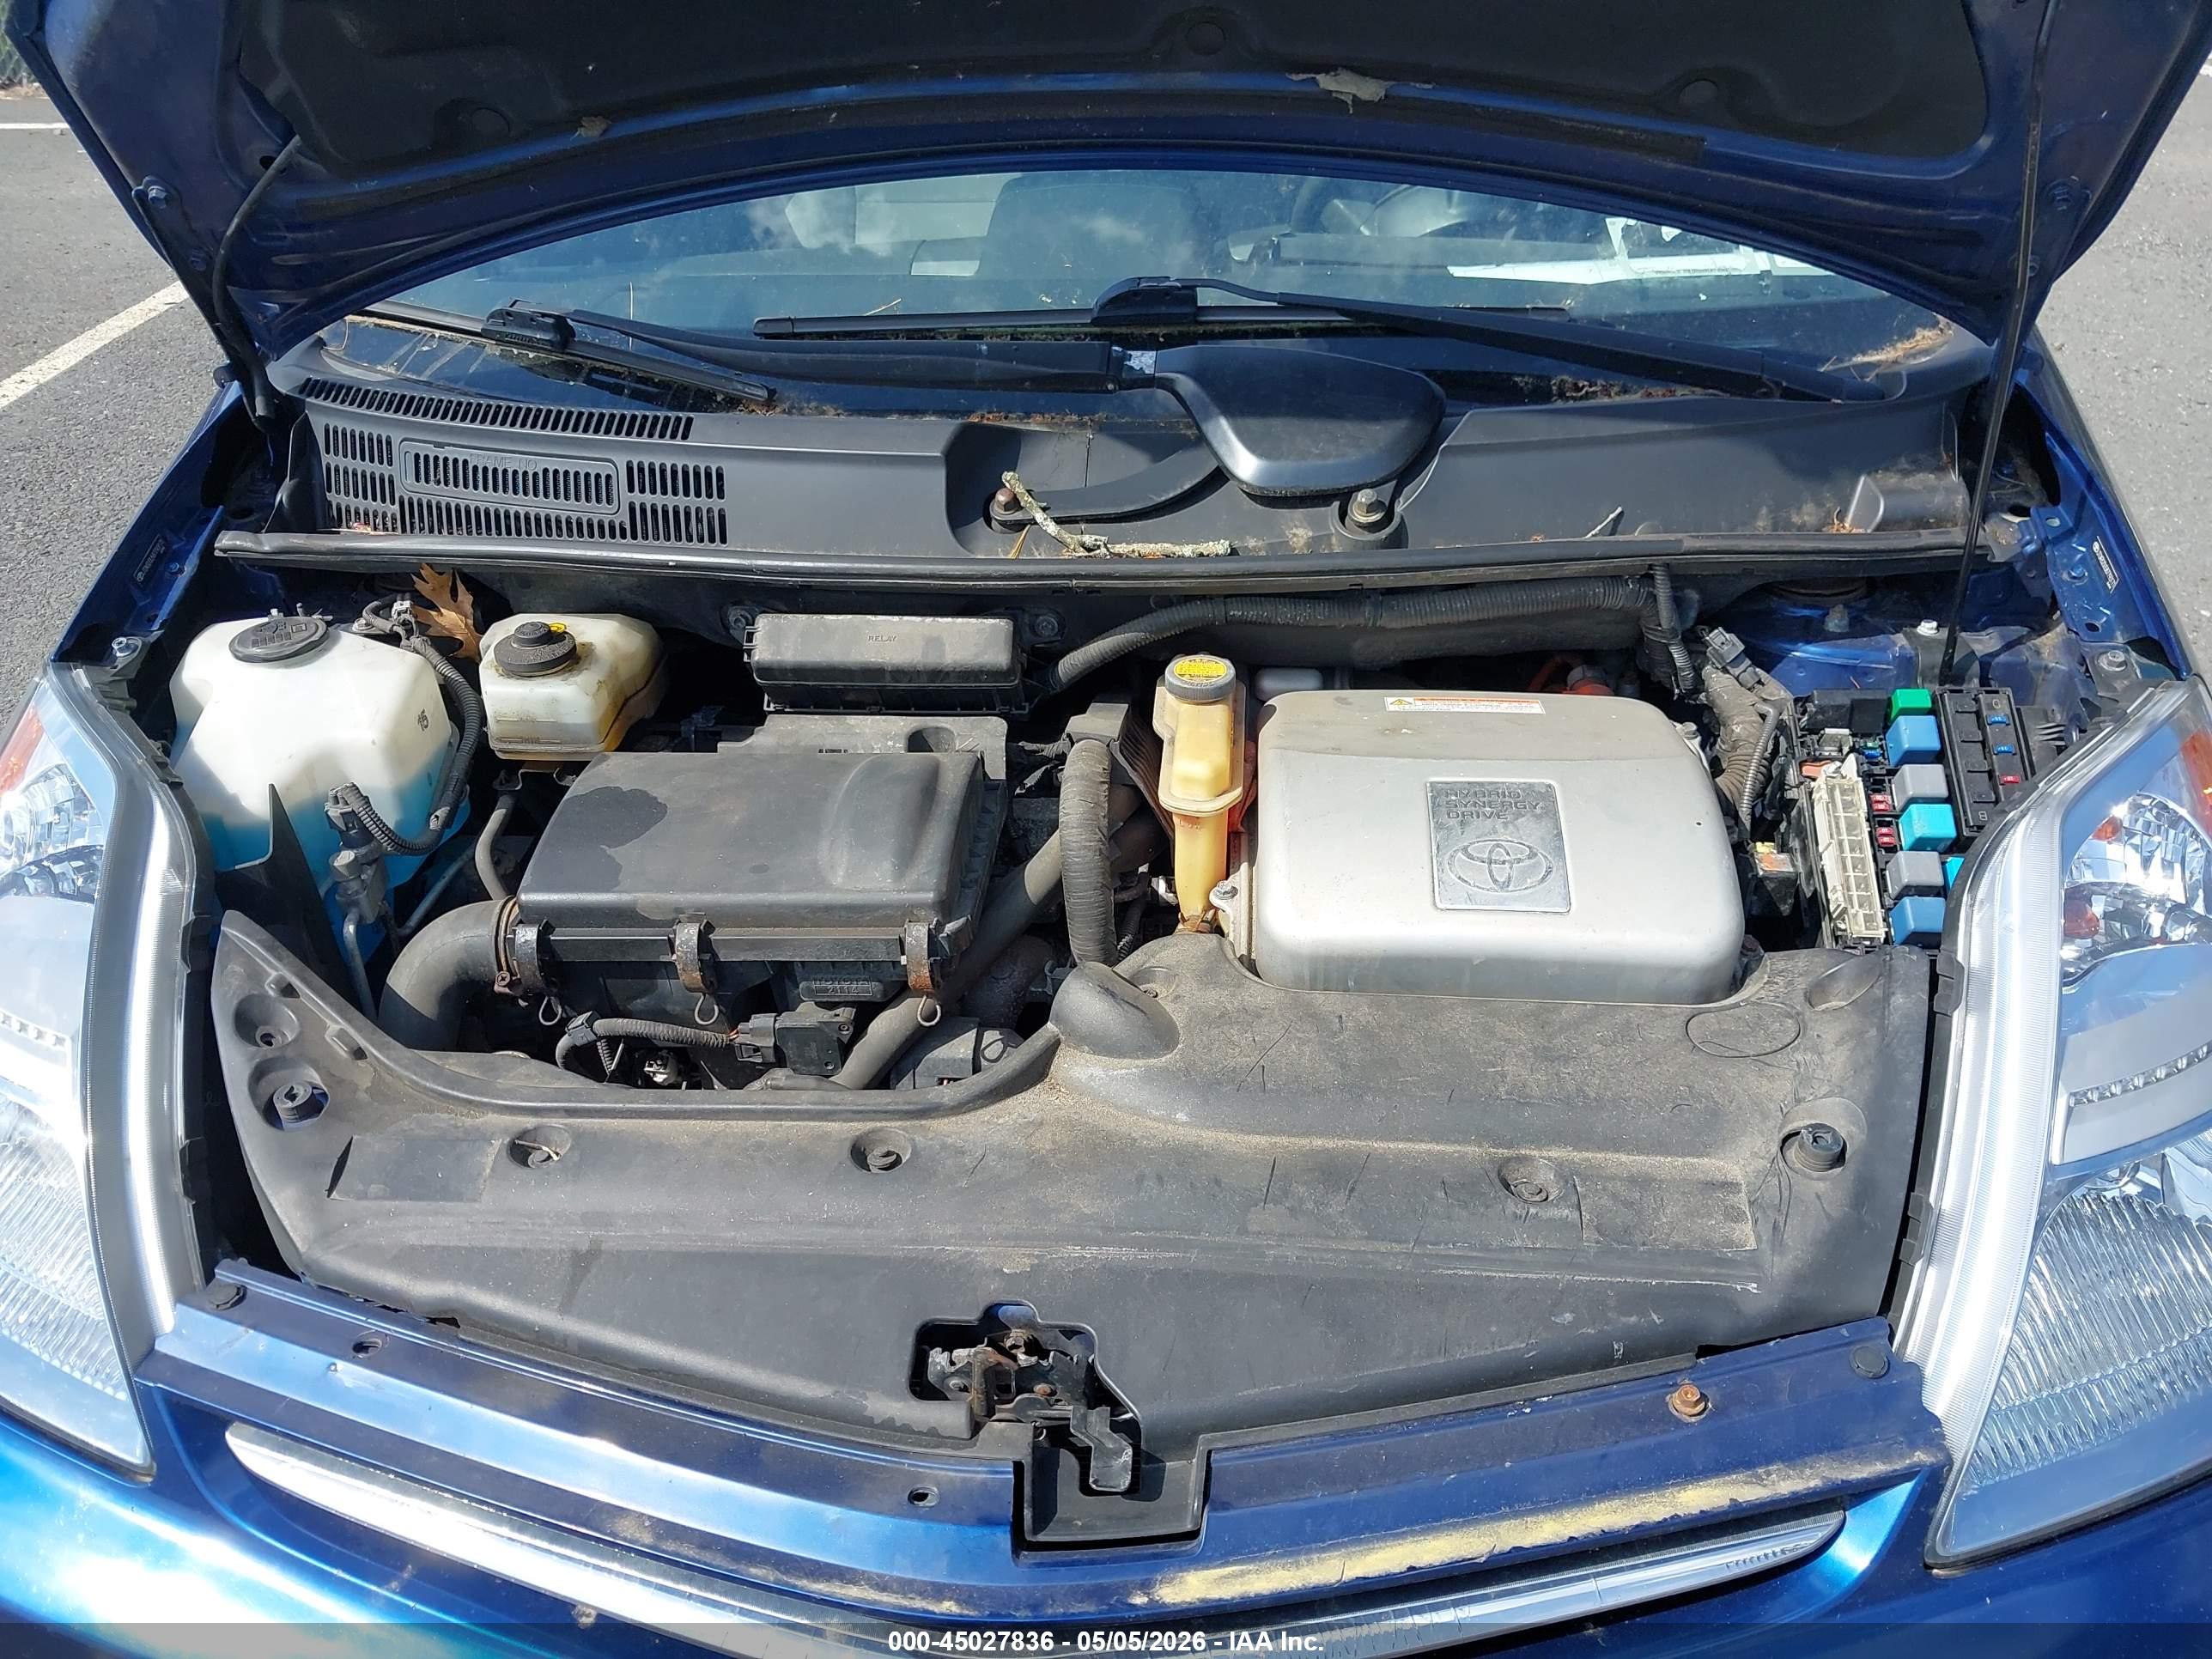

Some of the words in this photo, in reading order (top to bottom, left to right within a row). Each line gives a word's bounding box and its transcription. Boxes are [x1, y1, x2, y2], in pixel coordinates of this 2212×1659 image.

[470, 453, 512, 469] FRAME
[519, 460, 538, 471] NO
[1444, 789, 1522, 799] HYBRID
[1444, 799, 1542, 811] SYNERGY
[1447, 811, 1509, 819] DRIVE
[826, 985, 860, 995] 2114
